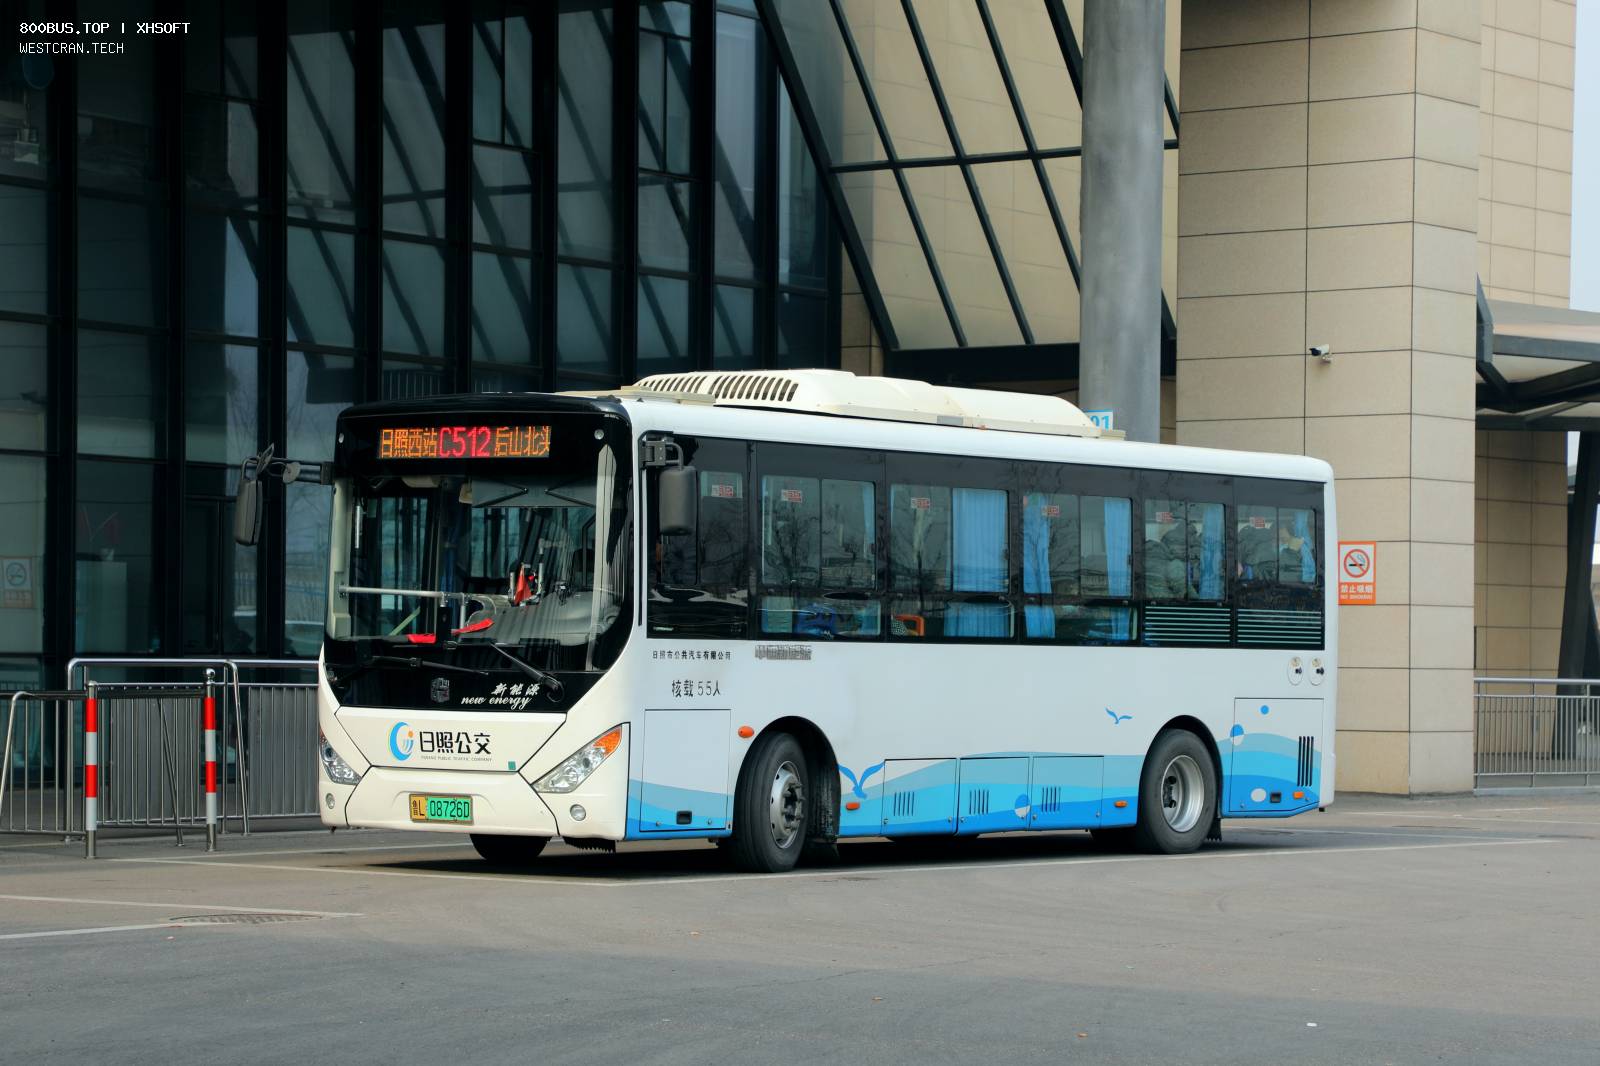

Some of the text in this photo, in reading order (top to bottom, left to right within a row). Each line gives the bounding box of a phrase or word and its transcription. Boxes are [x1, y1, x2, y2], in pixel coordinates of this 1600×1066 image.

[381, 427, 438, 458] 日照西站
[439, 426, 491, 458] C512
[651, 650, 732, 661] 日照市公共汽车有限公司
[491, 682, 540, 697] 新能源
[461, 696, 532, 710] new energy
[419, 731, 492, 755] 日照公交
[429, 800, 470, 818] 08726D
